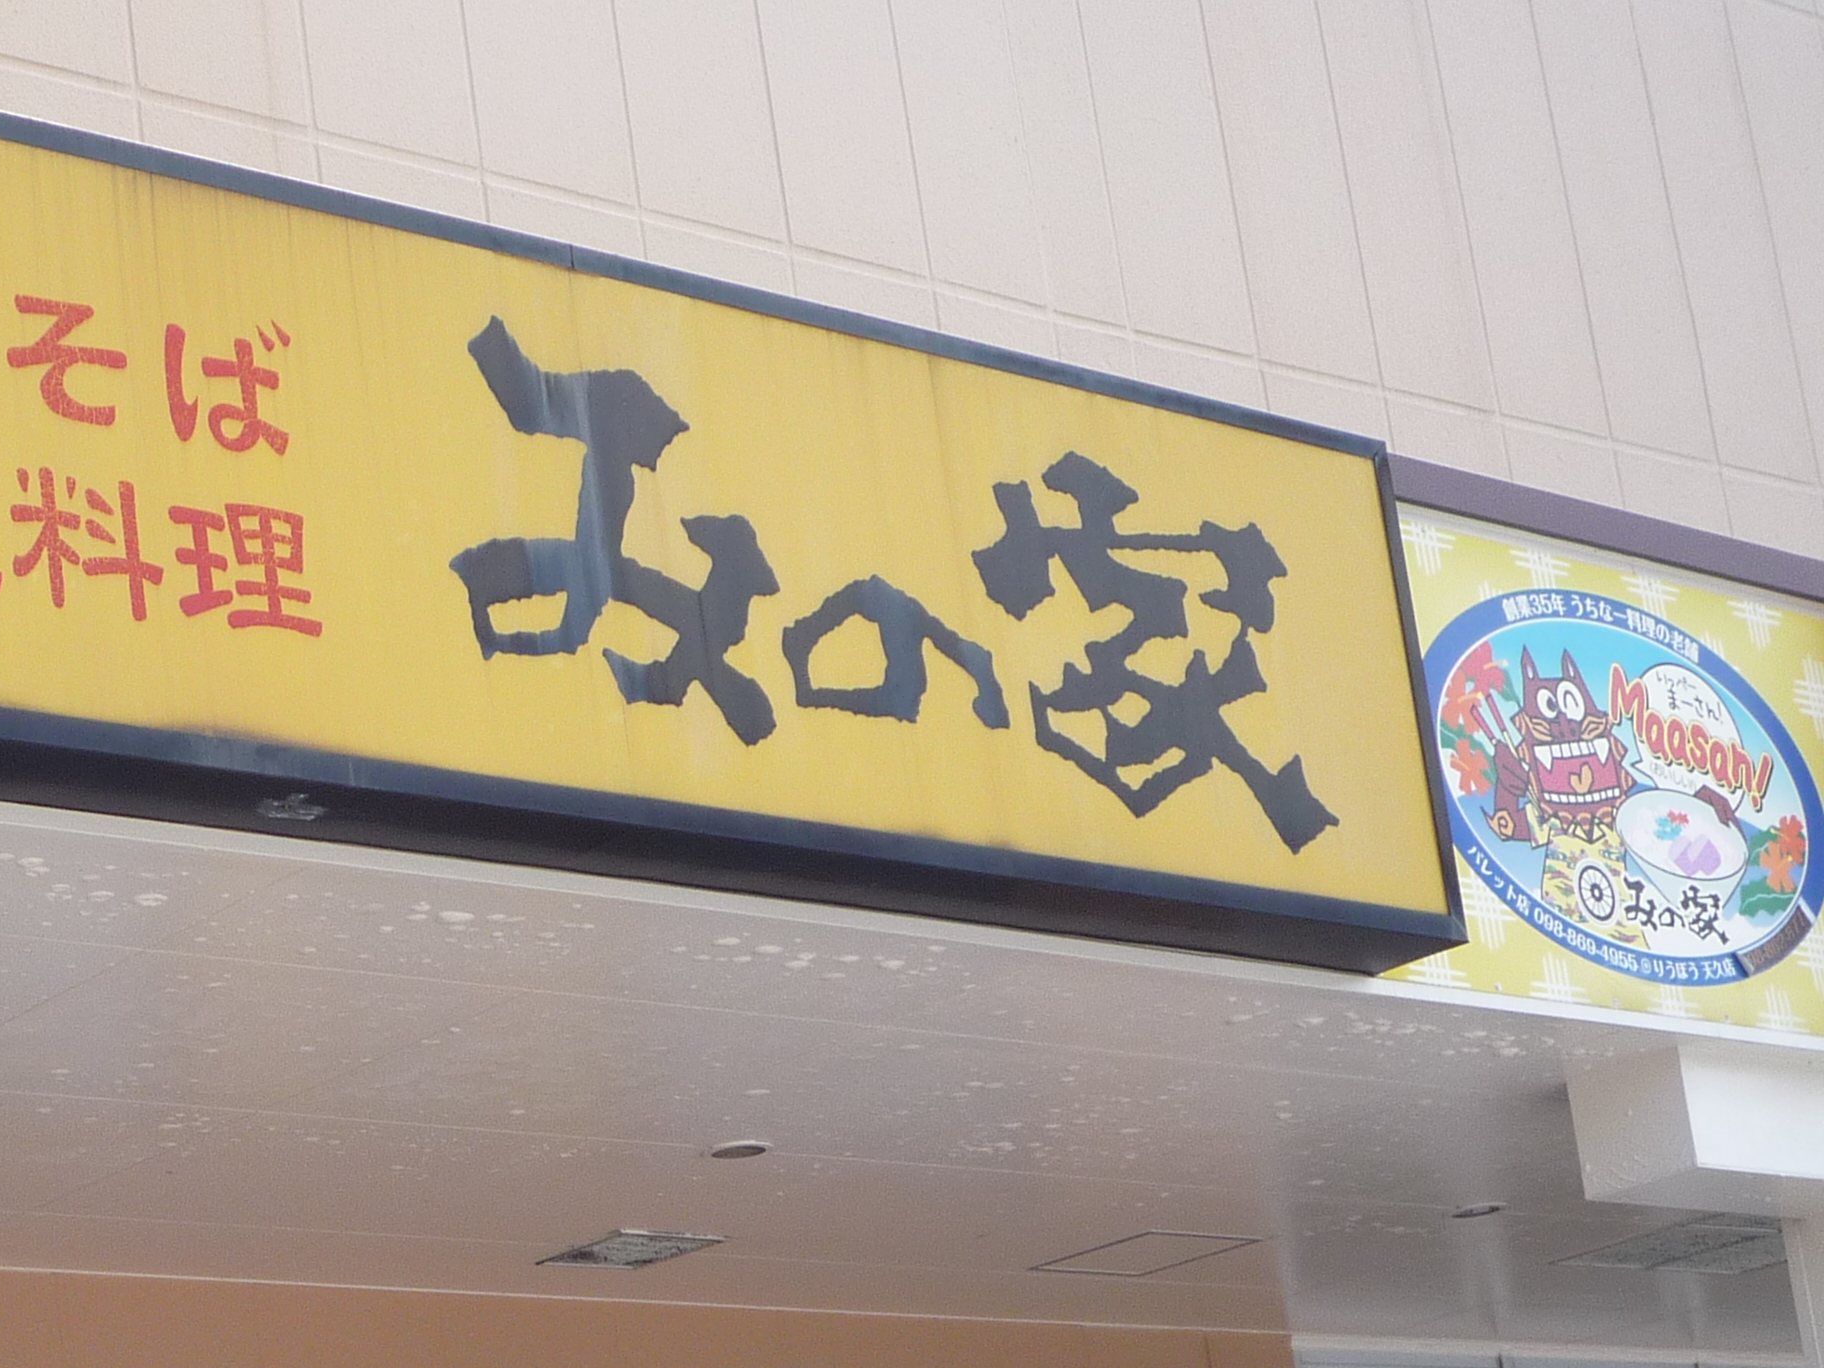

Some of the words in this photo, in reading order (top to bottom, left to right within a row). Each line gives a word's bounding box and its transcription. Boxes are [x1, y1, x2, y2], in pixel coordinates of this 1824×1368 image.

[448, 315, 1341, 856] みの家
[1570, 593, 1701, 664] うちなー料理の老舗
[1608, 662, 1774, 813] Maasan!
